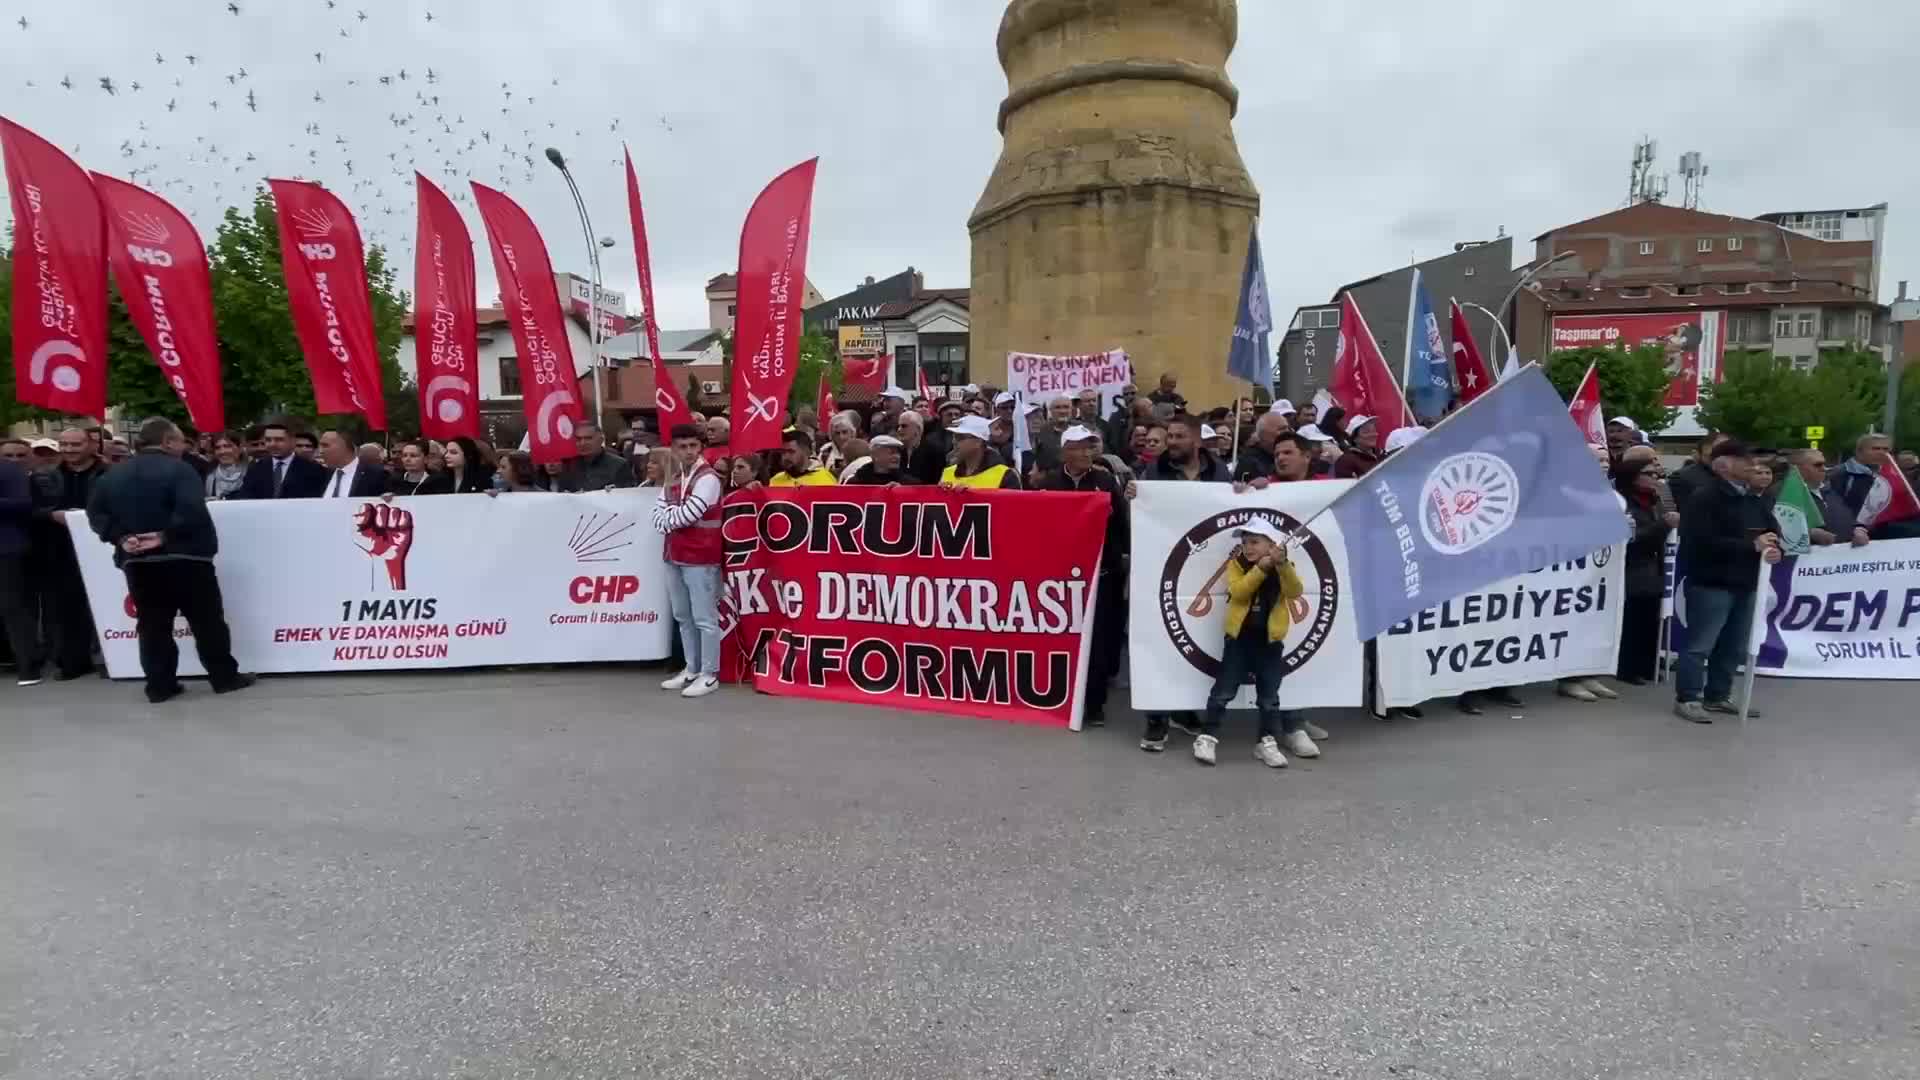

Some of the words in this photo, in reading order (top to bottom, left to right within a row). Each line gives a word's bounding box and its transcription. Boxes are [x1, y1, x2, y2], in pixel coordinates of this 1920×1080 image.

[722, 500, 993, 566] ÇORUM
[1798, 563, 1861, 577] HALKLARIN
[569, 575, 640, 604] CHP
[772, 579, 803, 619] ve
[816, 567, 1086, 634] DEMOKRASİ
[341, 599, 353, 622] 1
[358, 598, 438, 622] MAYIS
[550, 612, 588, 625] Çorum
[600, 610, 658, 624] Başkanlığı
[1780, 589, 1889, 632] DEM
[273, 627, 323, 643] EMEK
[328, 626, 351, 641] VE
[355, 623, 449, 642] DAYANIŞMA
[455, 618, 507, 637] GÜNÜ
[333, 645, 389, 661] KUTLU
[393, 643, 448, 659] OLSUN
[1426, 630, 1569, 676] YOZGAT
[1815, 641, 1885, 662] ÇORUM
[1888, 637, 1912, 659] İL
